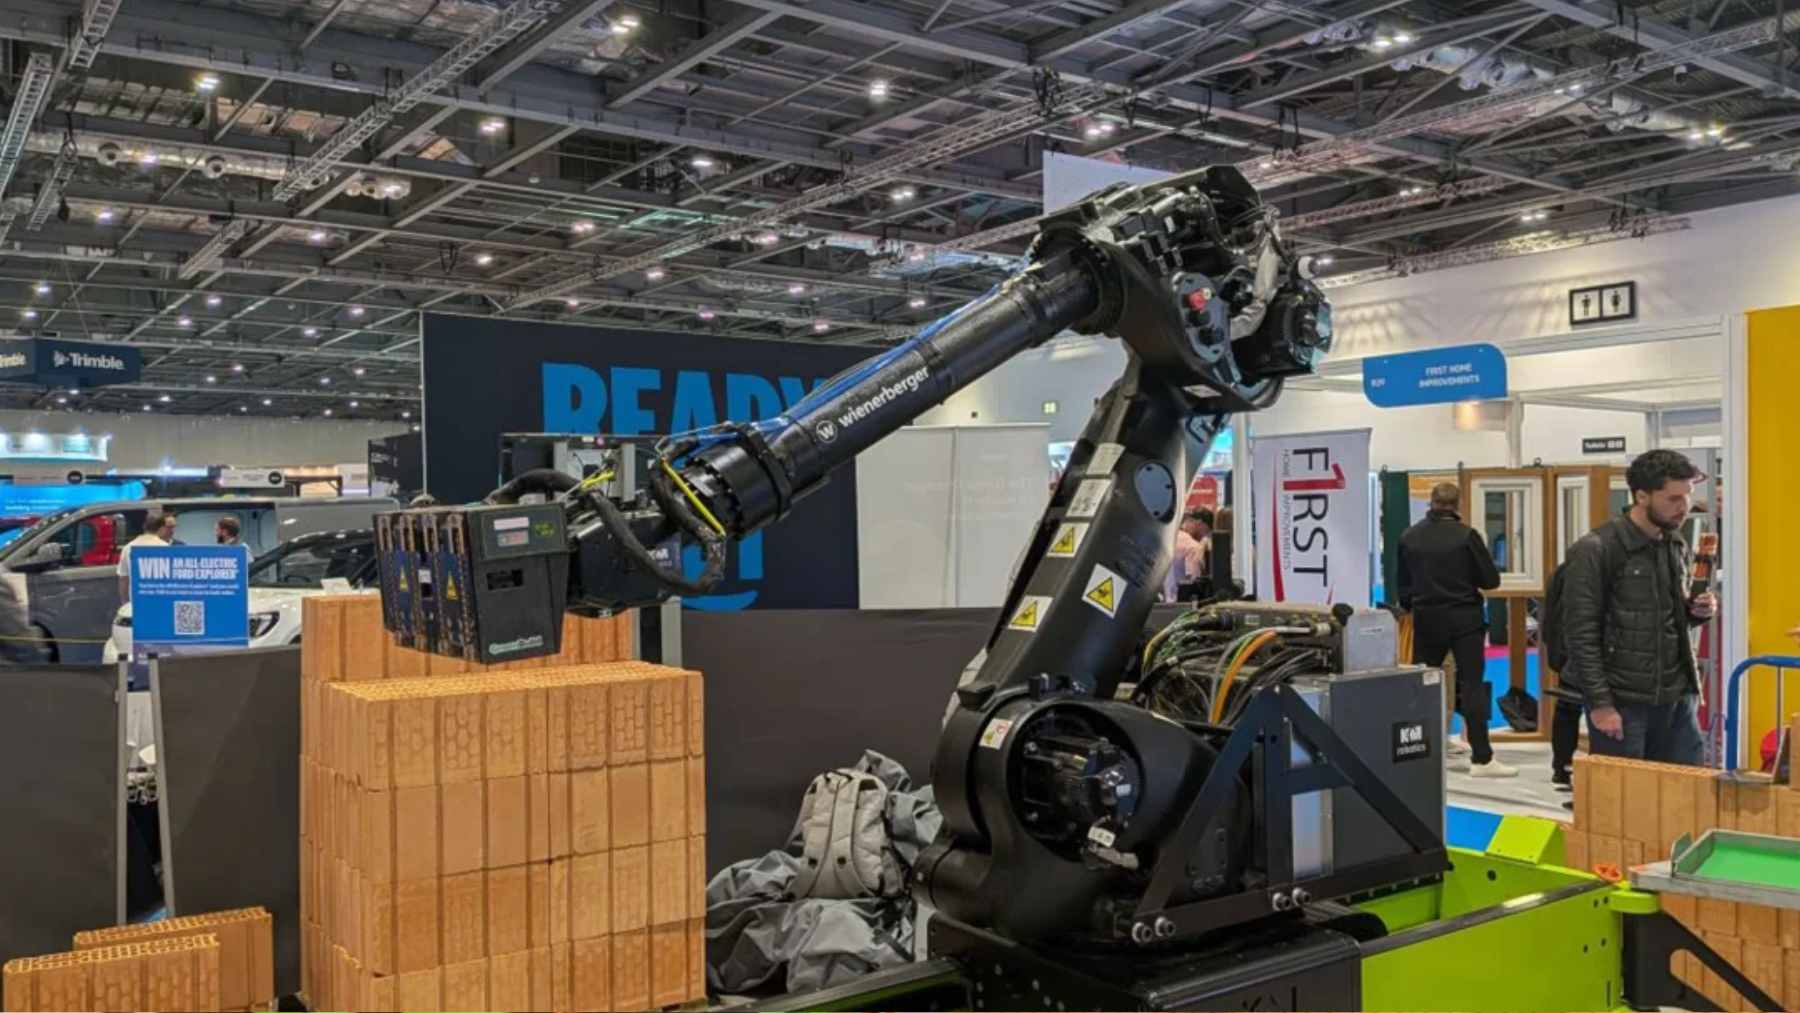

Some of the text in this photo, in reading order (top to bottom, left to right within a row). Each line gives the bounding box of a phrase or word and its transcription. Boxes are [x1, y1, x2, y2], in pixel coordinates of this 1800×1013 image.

[69, 352, 124, 370] Trimble
[1425, 362, 1473, 376] FIRST HOME
[1419, 374, 1480, 388] IMPROVEMENTS
[838, 366, 929, 427] wienerberger
[1282, 446, 1346, 588] F1RST
[1282, 494, 1293, 571] IMPROVEMENTS
[138, 557, 170, 579] WIN
[184, 557, 237, 568] ALL-ELECTRIC
[172, 569, 194, 579] FORD
